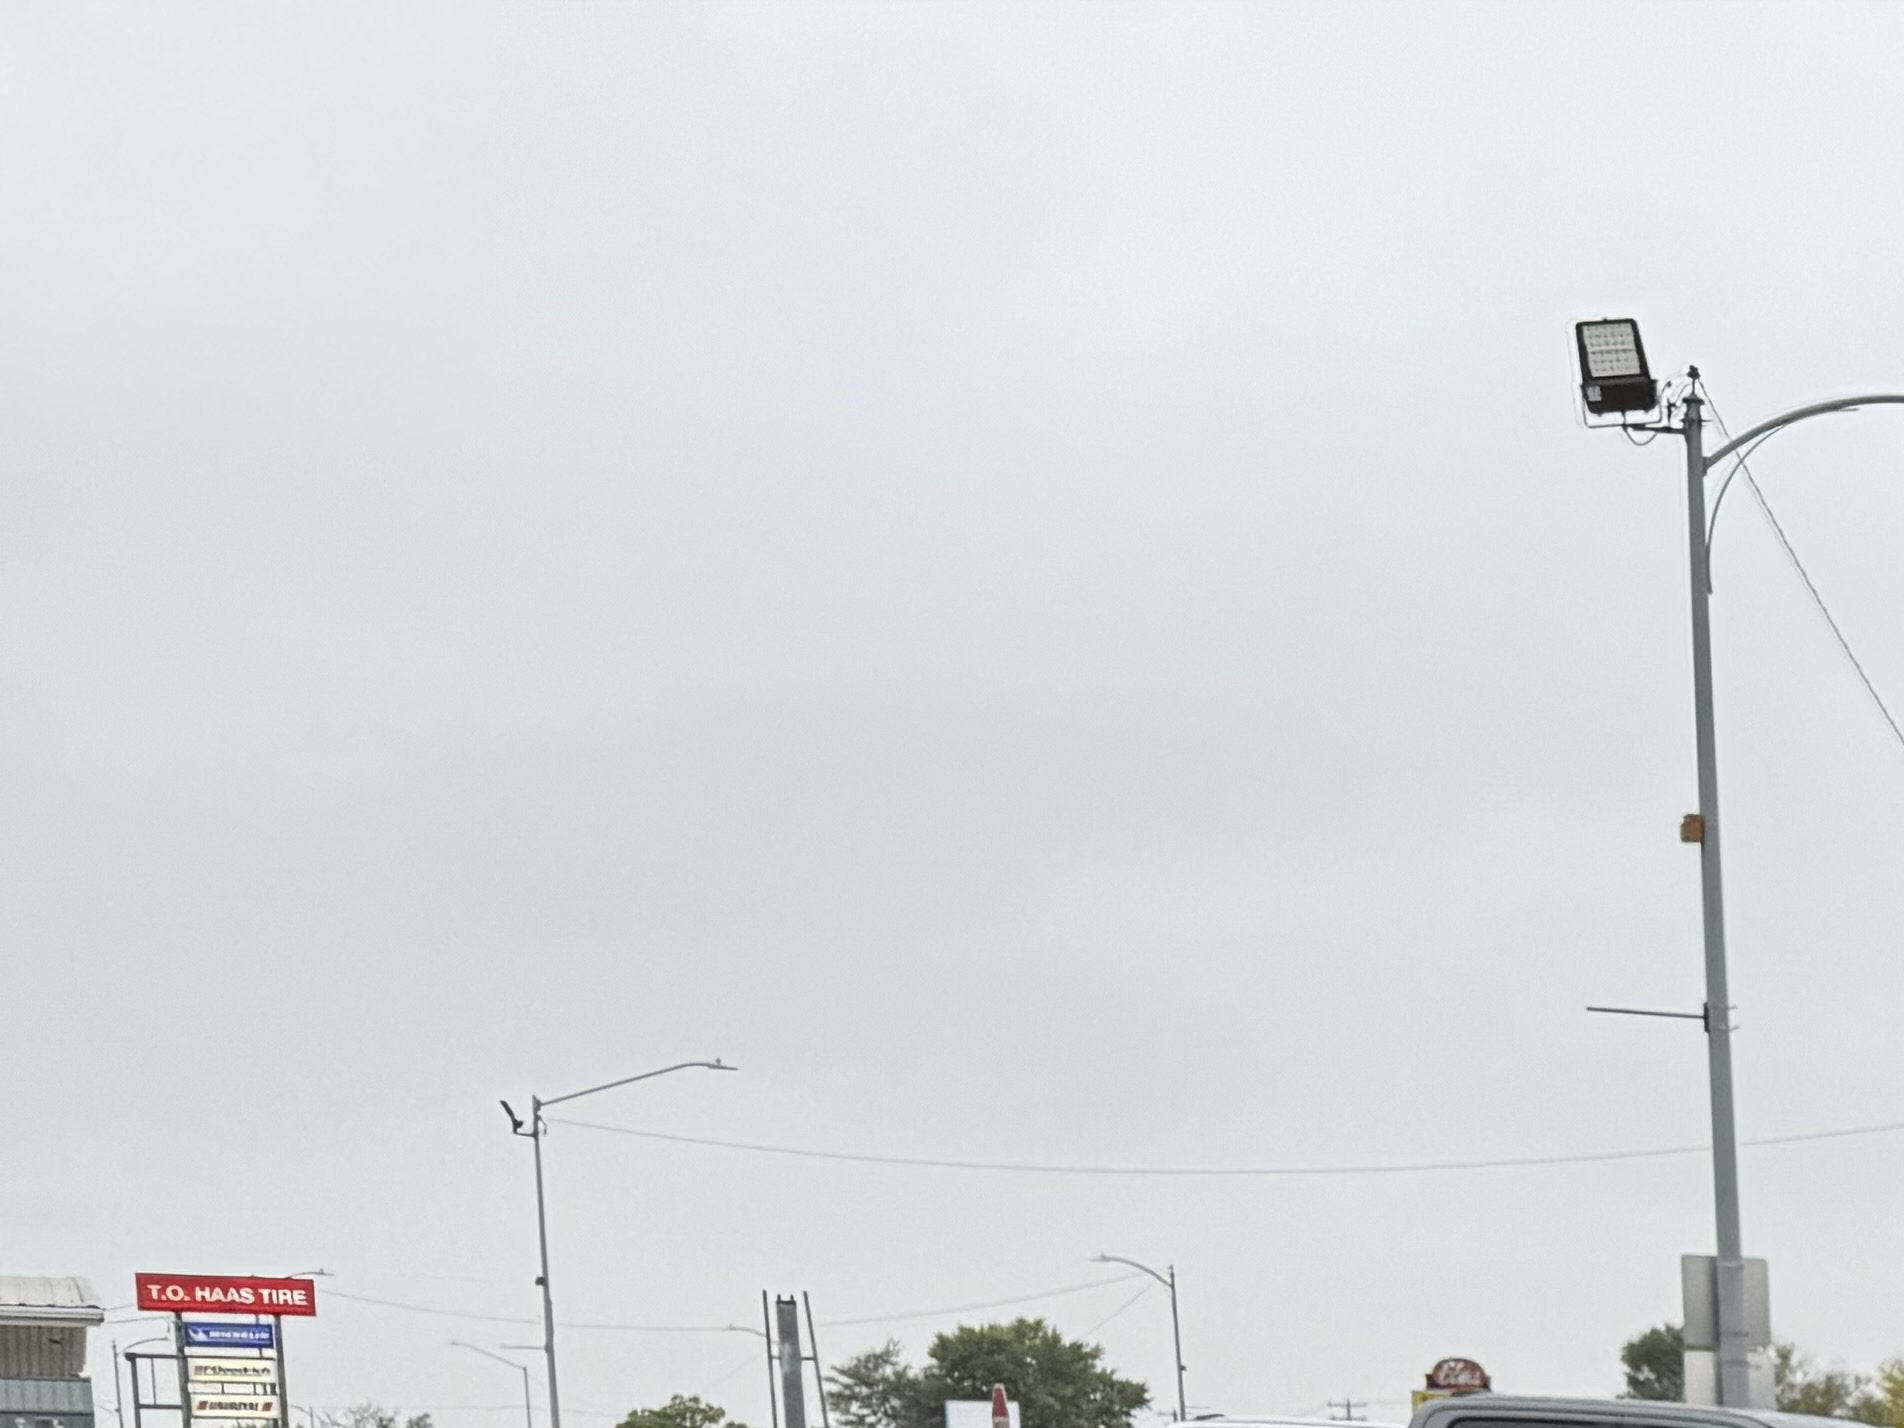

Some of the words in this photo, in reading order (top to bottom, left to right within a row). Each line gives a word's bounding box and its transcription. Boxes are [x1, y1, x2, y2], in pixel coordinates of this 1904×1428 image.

[147, 1284, 190, 1301] T.O.
[195, 1286, 255, 1304] HAAS
[258, 1288, 308, 1305] TIRE
